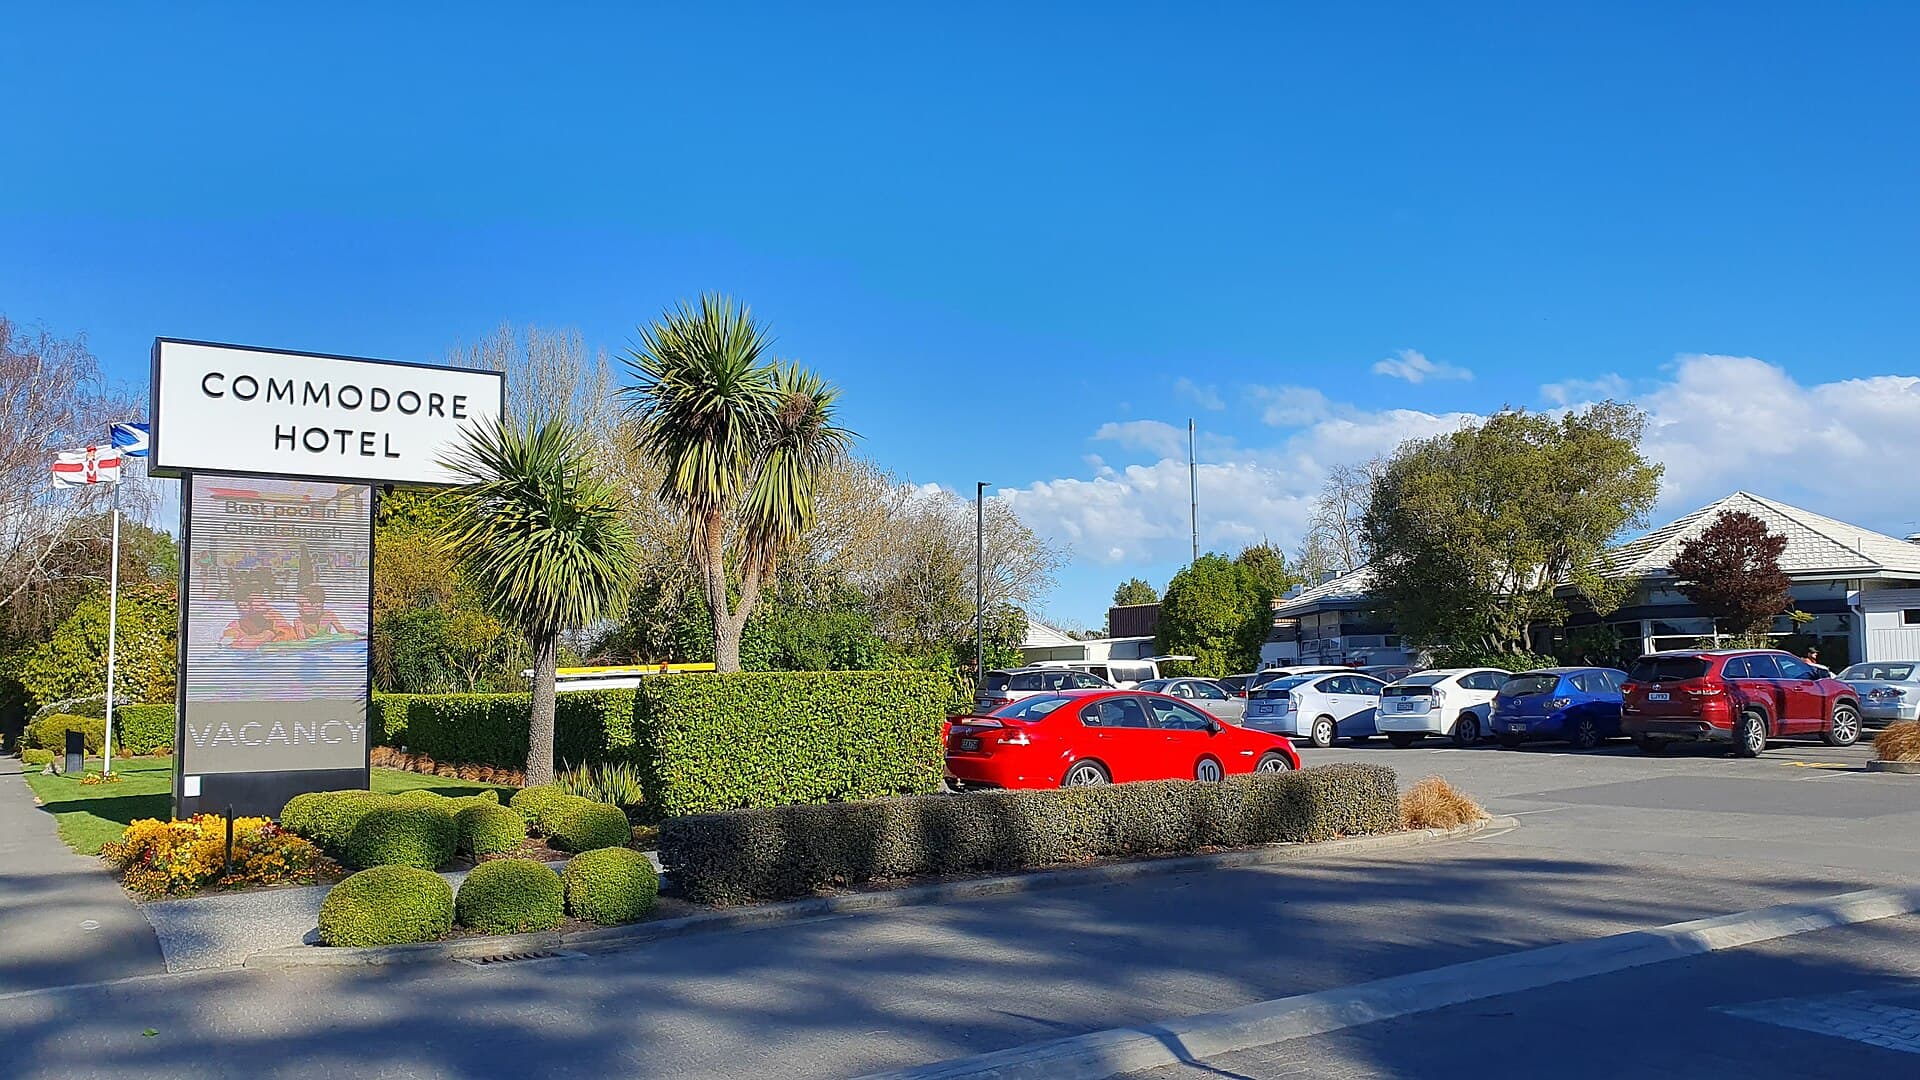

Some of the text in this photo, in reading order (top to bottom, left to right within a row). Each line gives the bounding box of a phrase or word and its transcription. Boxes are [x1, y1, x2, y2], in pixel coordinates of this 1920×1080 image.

[201, 372, 468, 419] COMMODORE
[274, 424, 401, 459] HOTEL
[225, 500, 338, 520] Best pool in
[188, 720, 367, 748] VACANCY
[1200, 764, 1217, 782] 10
